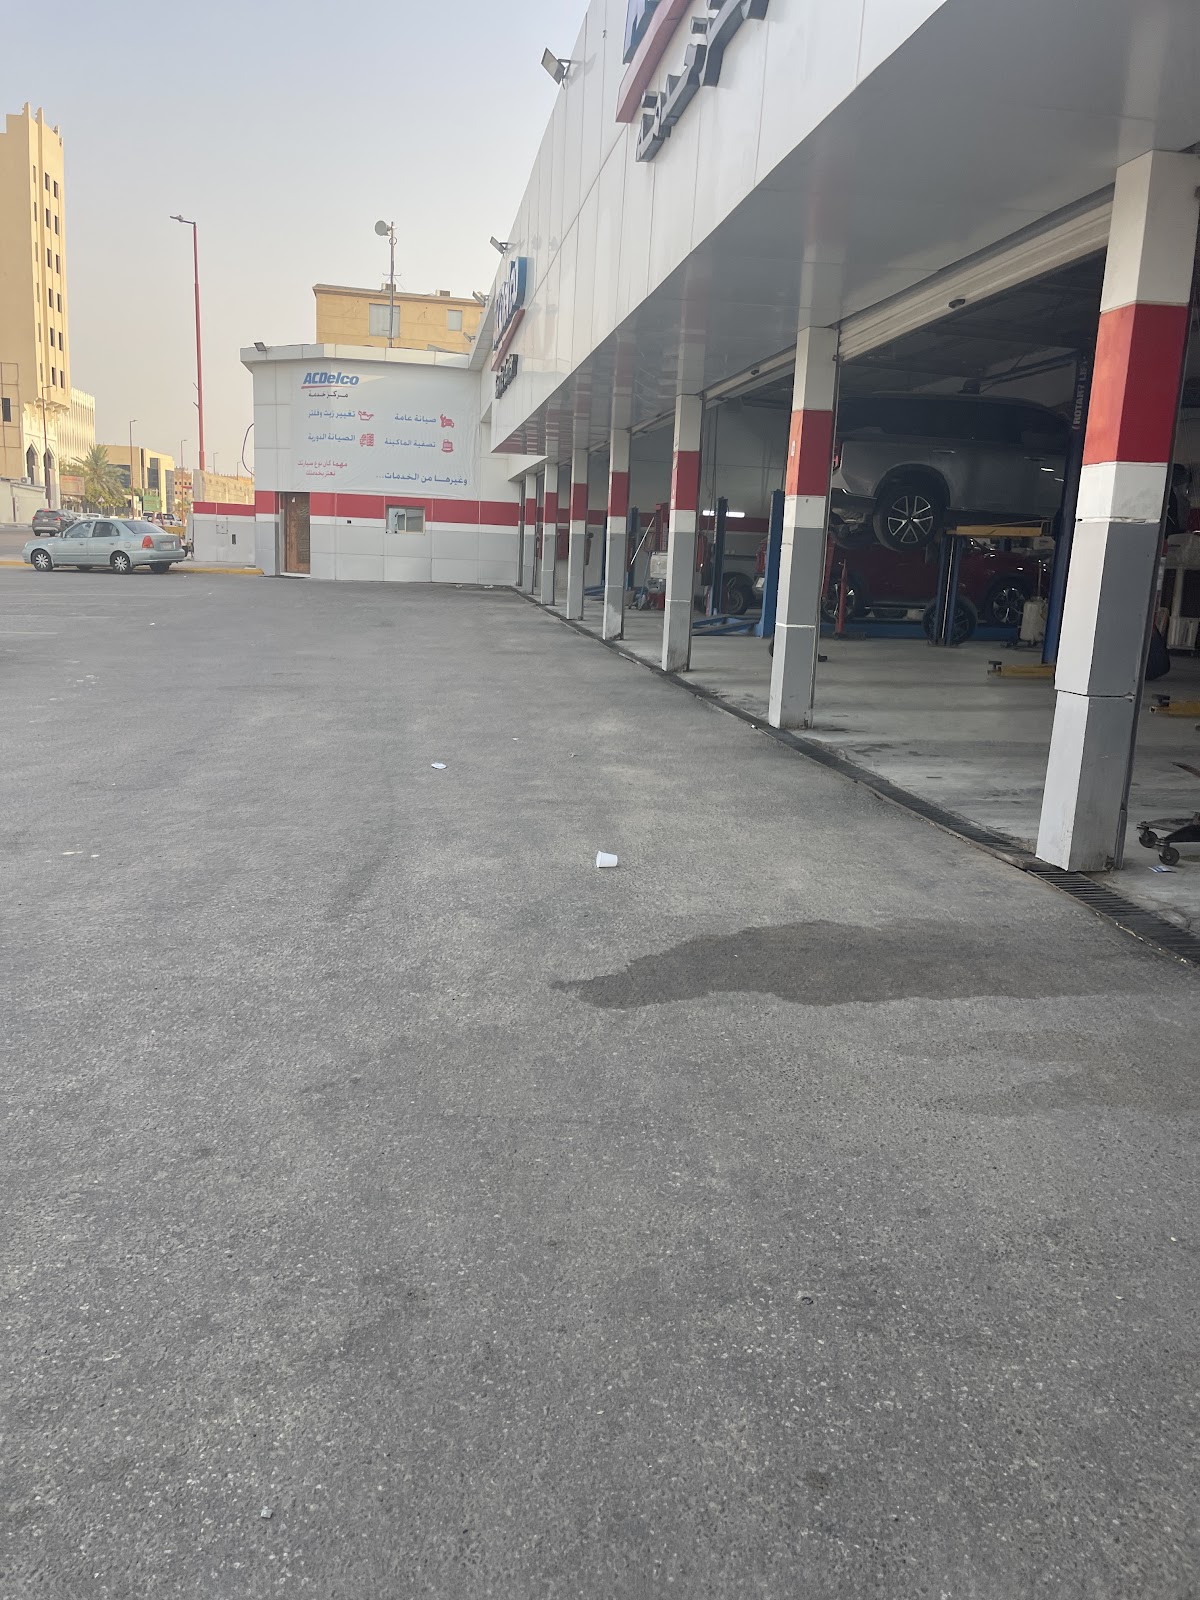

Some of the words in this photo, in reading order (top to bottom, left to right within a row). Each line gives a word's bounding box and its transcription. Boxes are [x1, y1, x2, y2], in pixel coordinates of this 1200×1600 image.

[303, 372, 360, 385] ACDelco
[308, 390, 326, 398] خدمة
[327, 390, 349, 399] مركز
[308, 409, 323, 418] وفلتر
[323, 409, 335, 418] زيت
[335, 409, 356, 419] تغيير
[394, 413, 412, 422] عامة
[413, 414, 437, 425] صيانة
[308, 432, 327, 442] الدورية
[327, 432, 356, 443] الصيانة
[384, 438, 412, 446] الماكينة
[413, 440, 436, 449] تصفية
[332, 460, 348, 469] مهما
[434, 474, 468, 486] وغيرها
